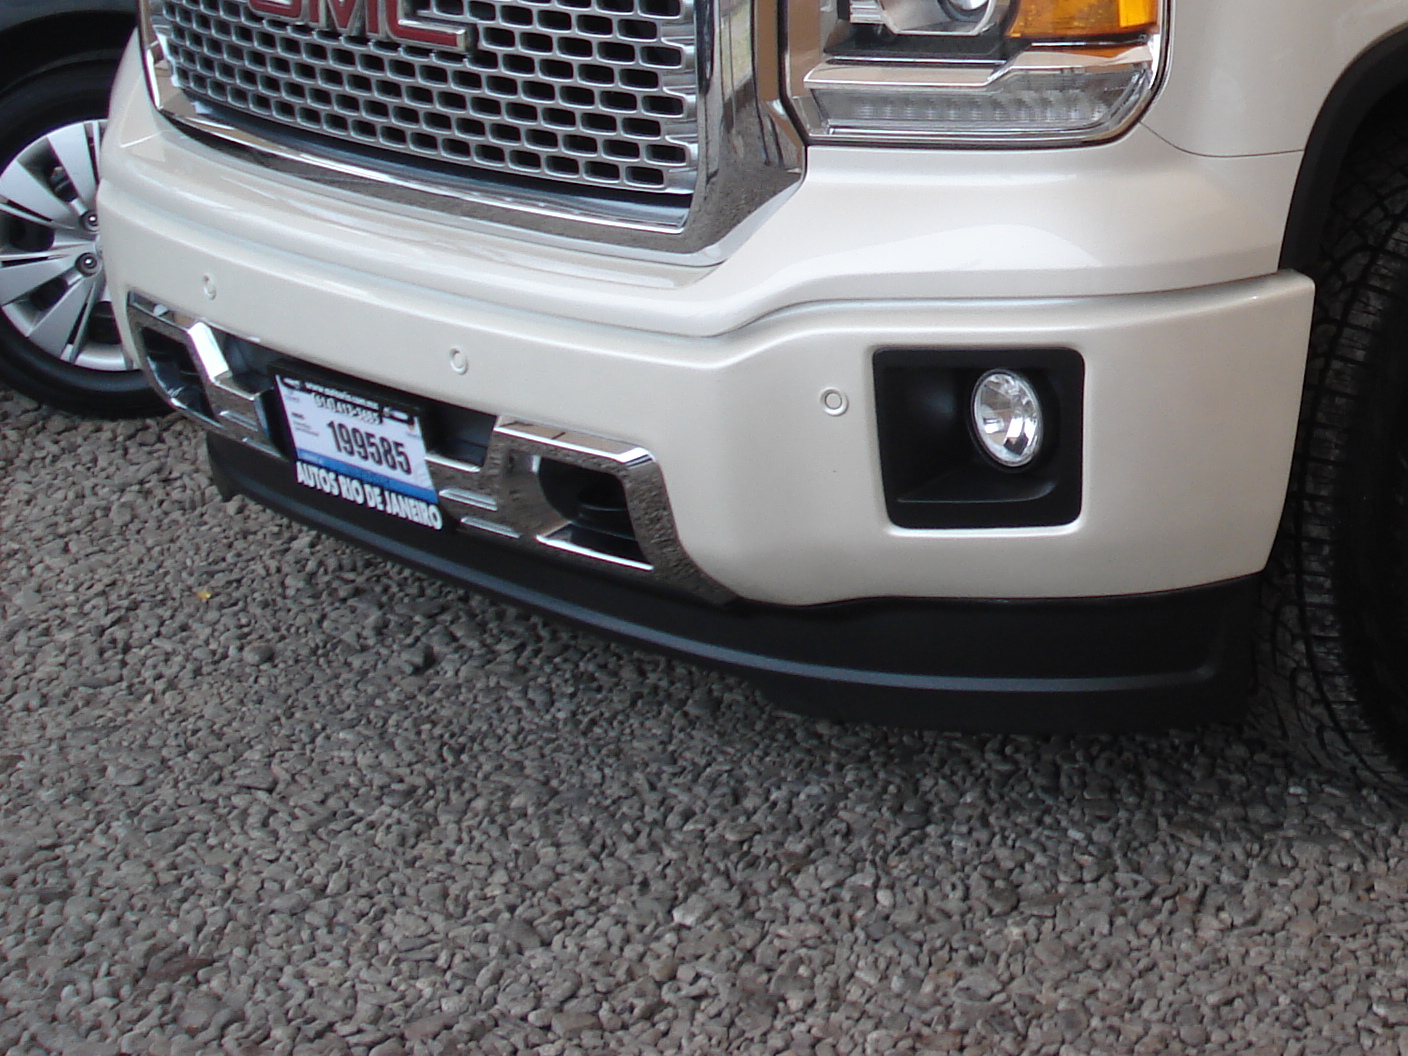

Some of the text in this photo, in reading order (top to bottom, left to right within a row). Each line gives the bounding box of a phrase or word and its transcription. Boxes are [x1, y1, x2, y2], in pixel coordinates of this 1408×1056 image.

[327, 420, 412, 476] 199585
[296, 461, 443, 531] AUTOS RIO DE JANEIRO
